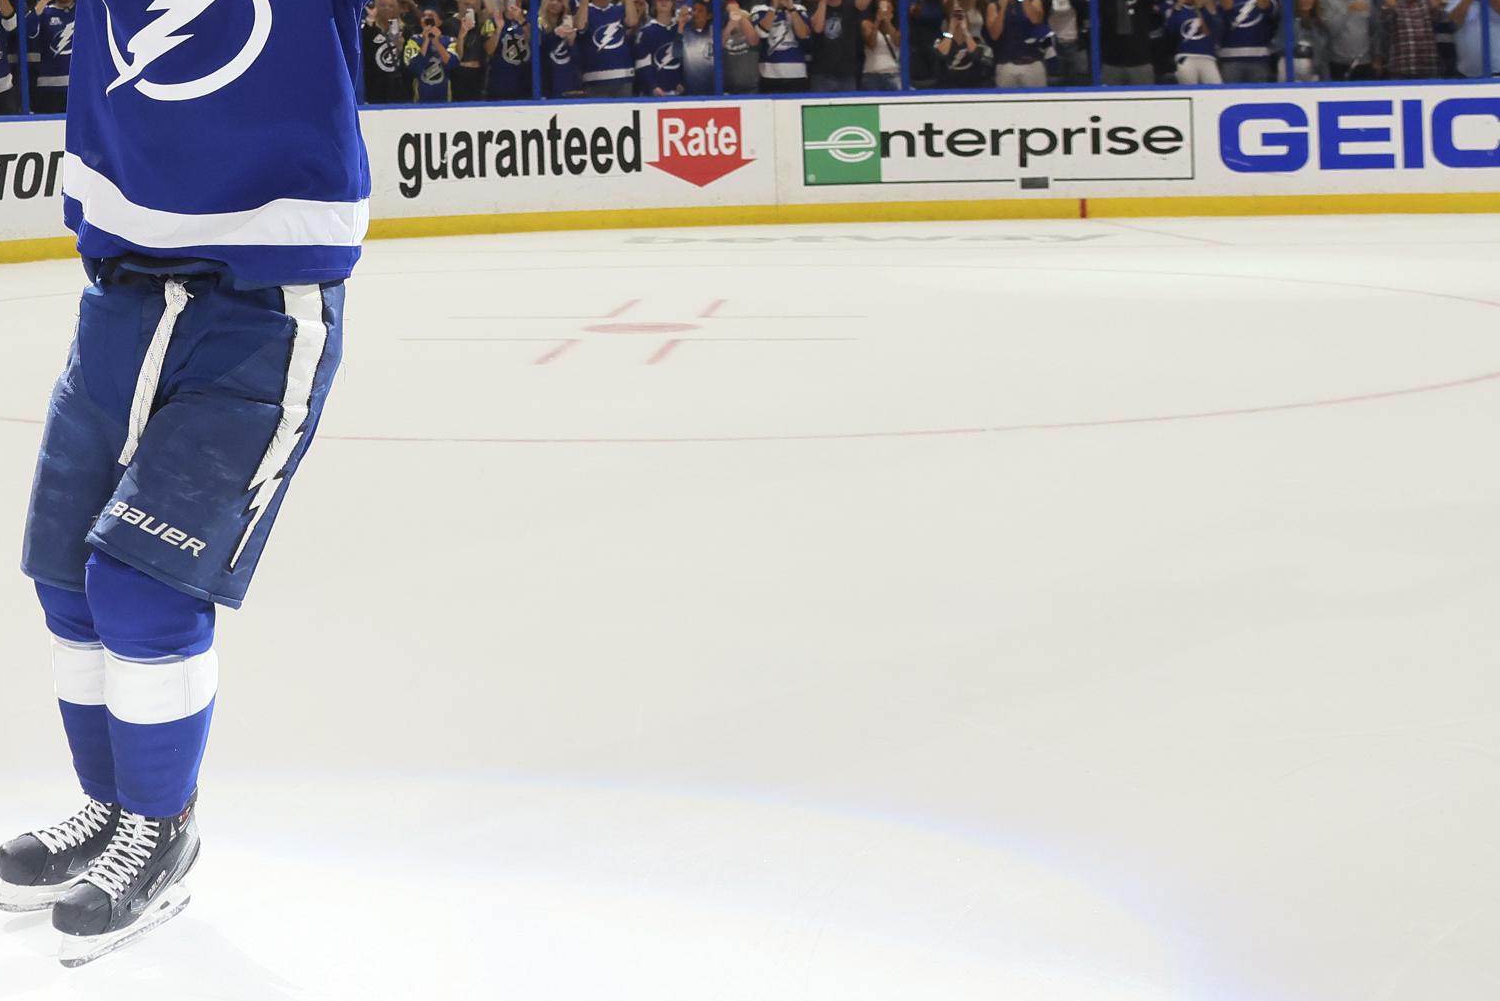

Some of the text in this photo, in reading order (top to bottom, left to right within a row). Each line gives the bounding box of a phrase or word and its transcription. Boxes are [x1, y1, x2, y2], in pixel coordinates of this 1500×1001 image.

[398, 109, 642, 199] guaranteed
[662, 117, 738, 158] Rate
[804, 115, 1184, 168] enterprise
